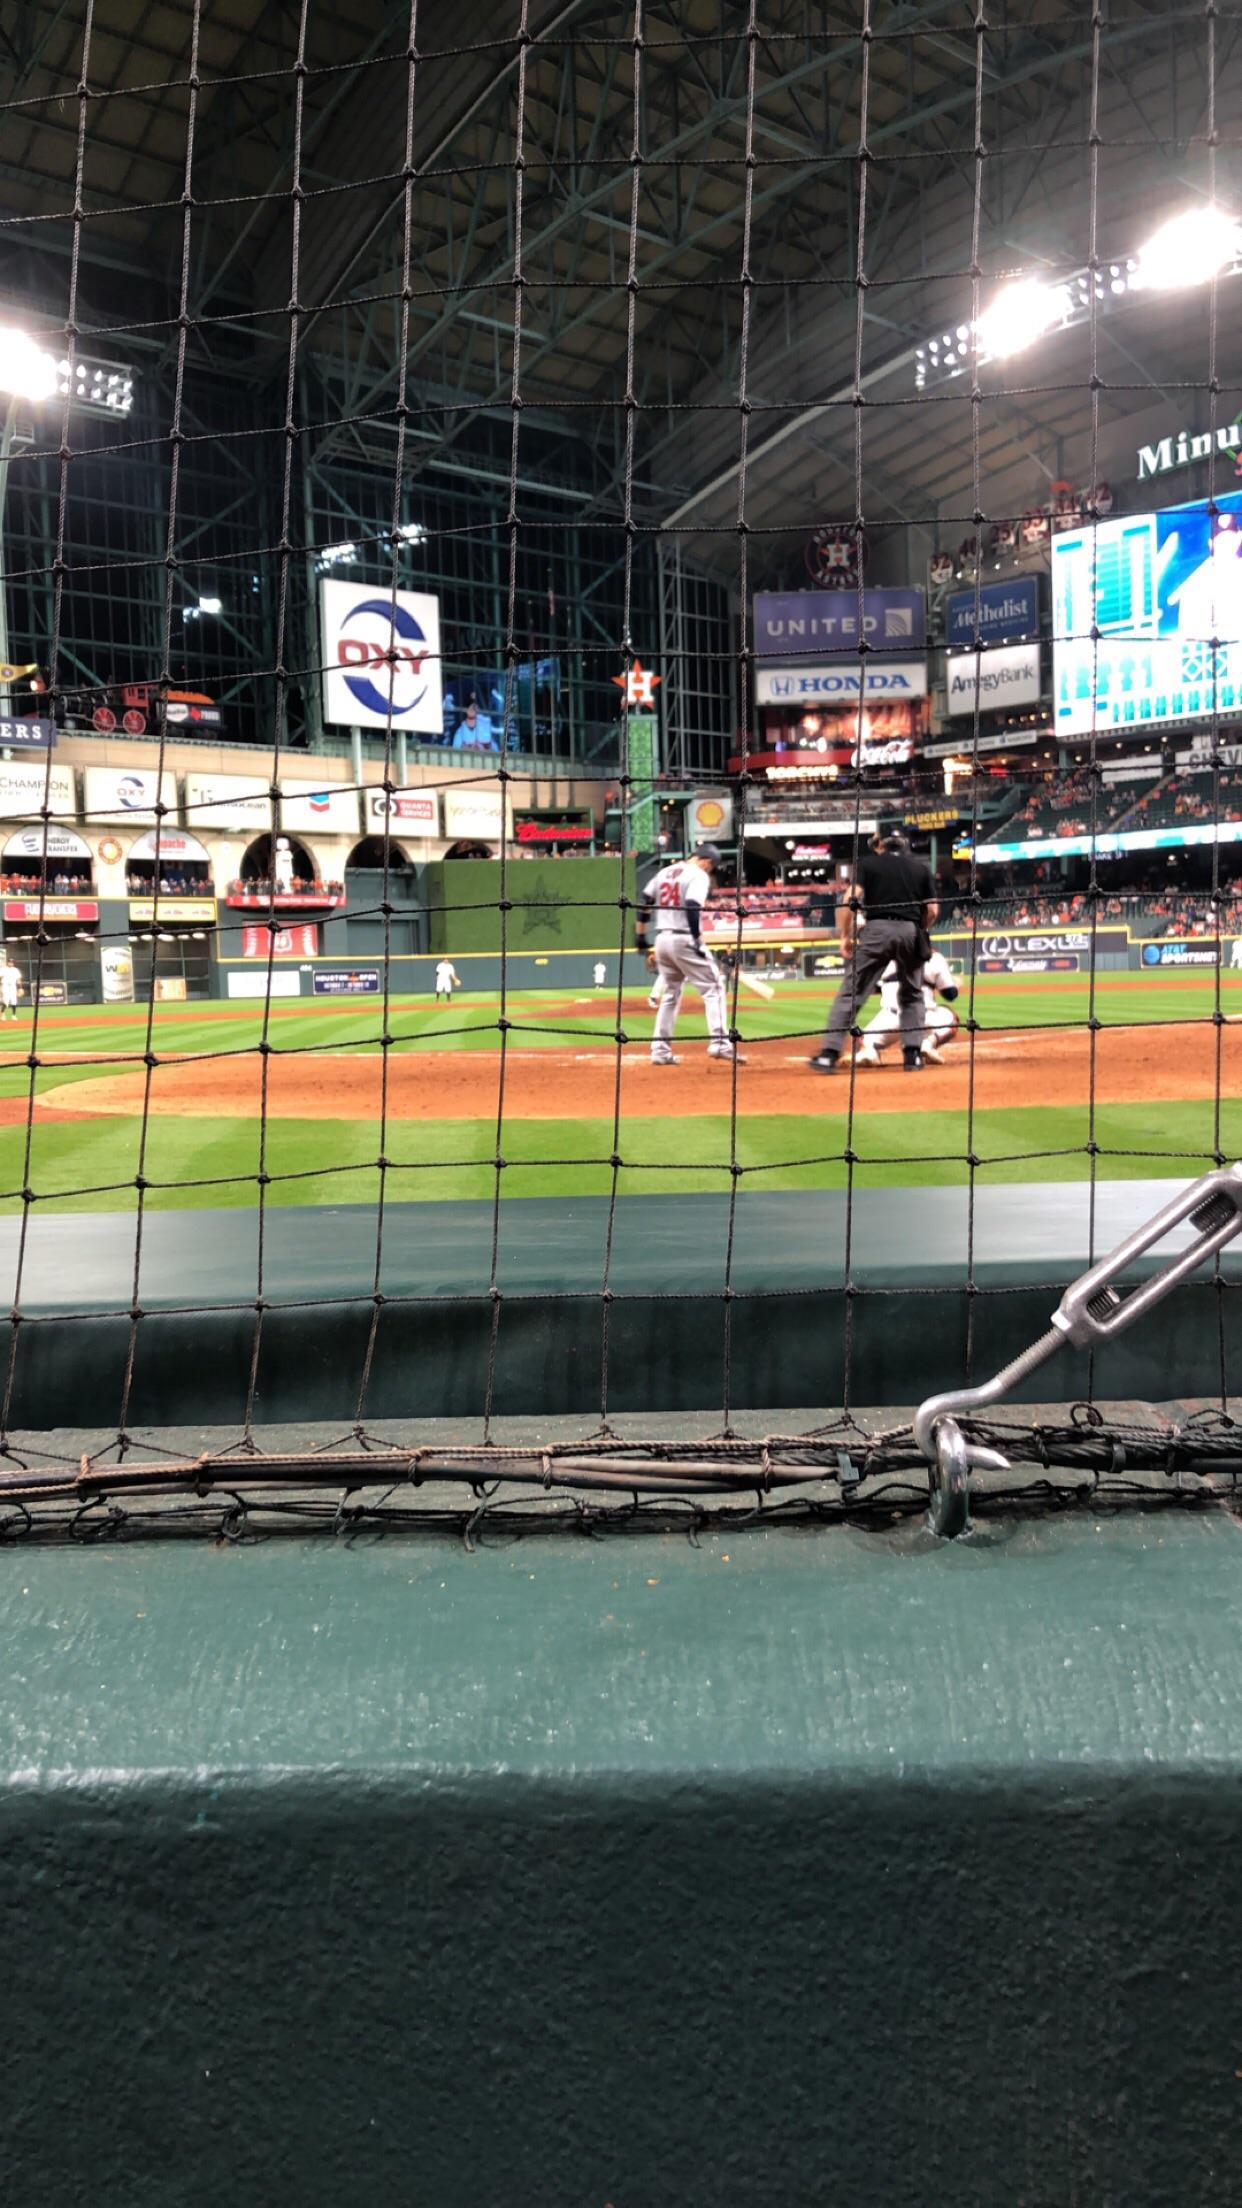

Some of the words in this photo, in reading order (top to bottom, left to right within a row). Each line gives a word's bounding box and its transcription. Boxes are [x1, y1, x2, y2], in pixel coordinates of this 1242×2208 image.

[1137, 424, 1241, 480] Minu
[766, 616, 878, 636] UNITED
[338, 639, 429, 675] OXY
[799, 674, 911, 692] HONDA
[951, 664, 1035, 694] AmegyBank
[0, 779, 69, 792] CHAMPON
[116, 788, 146, 797] OXY
[660, 882, 681, 907] 24
